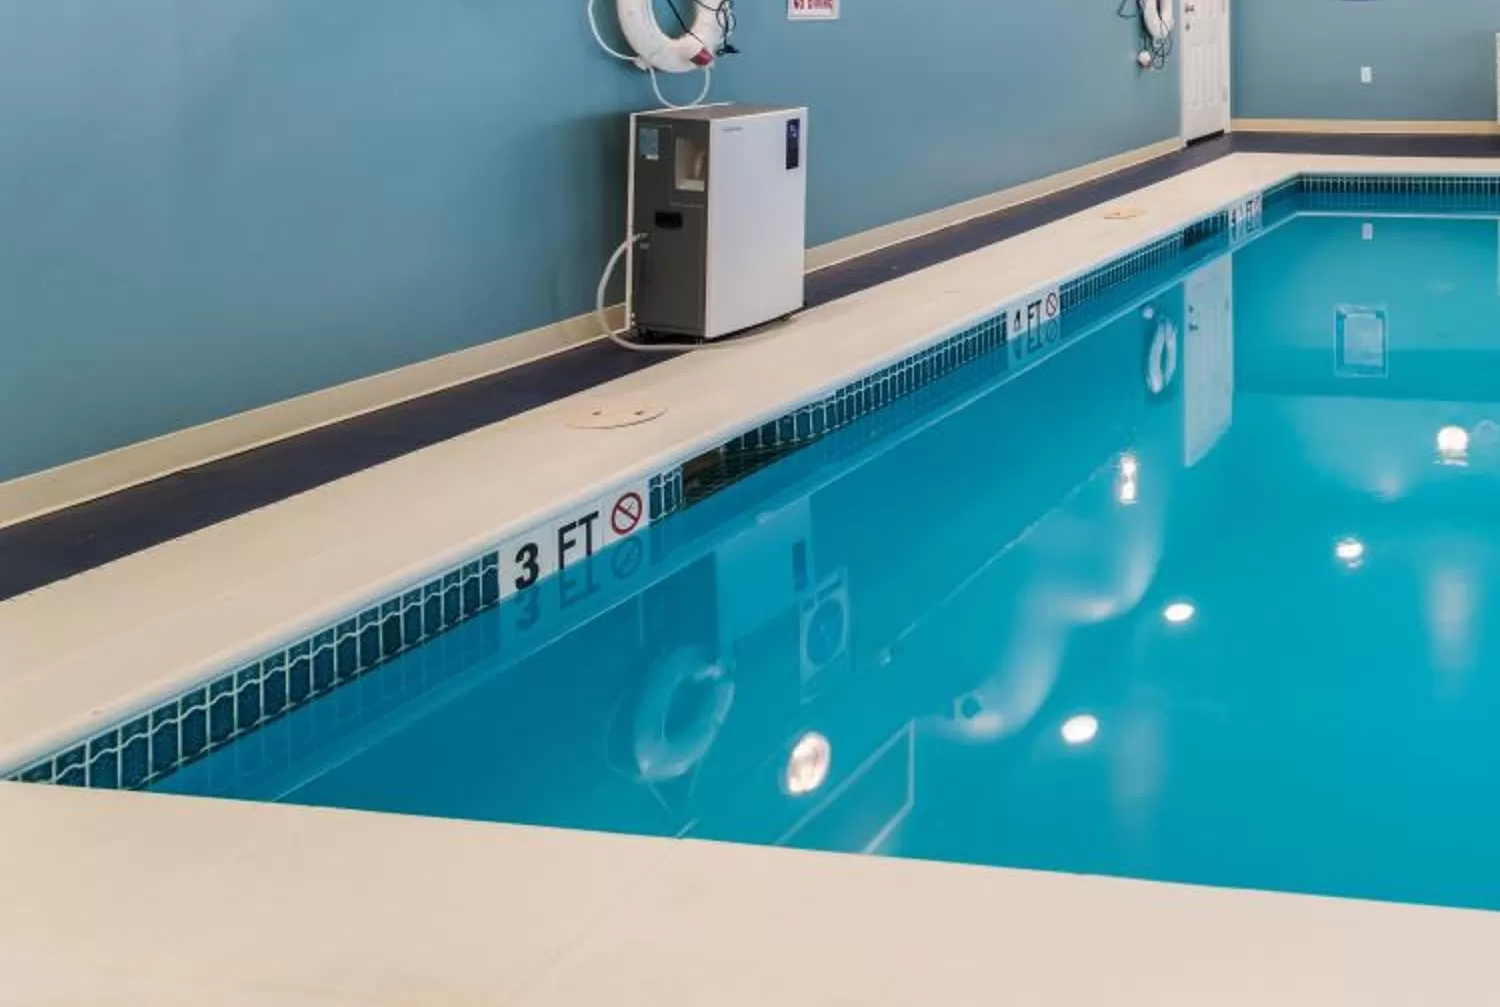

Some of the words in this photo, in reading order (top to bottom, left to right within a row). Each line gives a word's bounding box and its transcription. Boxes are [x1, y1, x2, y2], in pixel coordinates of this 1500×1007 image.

[1027, 299, 1042, 330] FT
[514, 542, 540, 590] 3
[558, 510, 599, 570] FT
